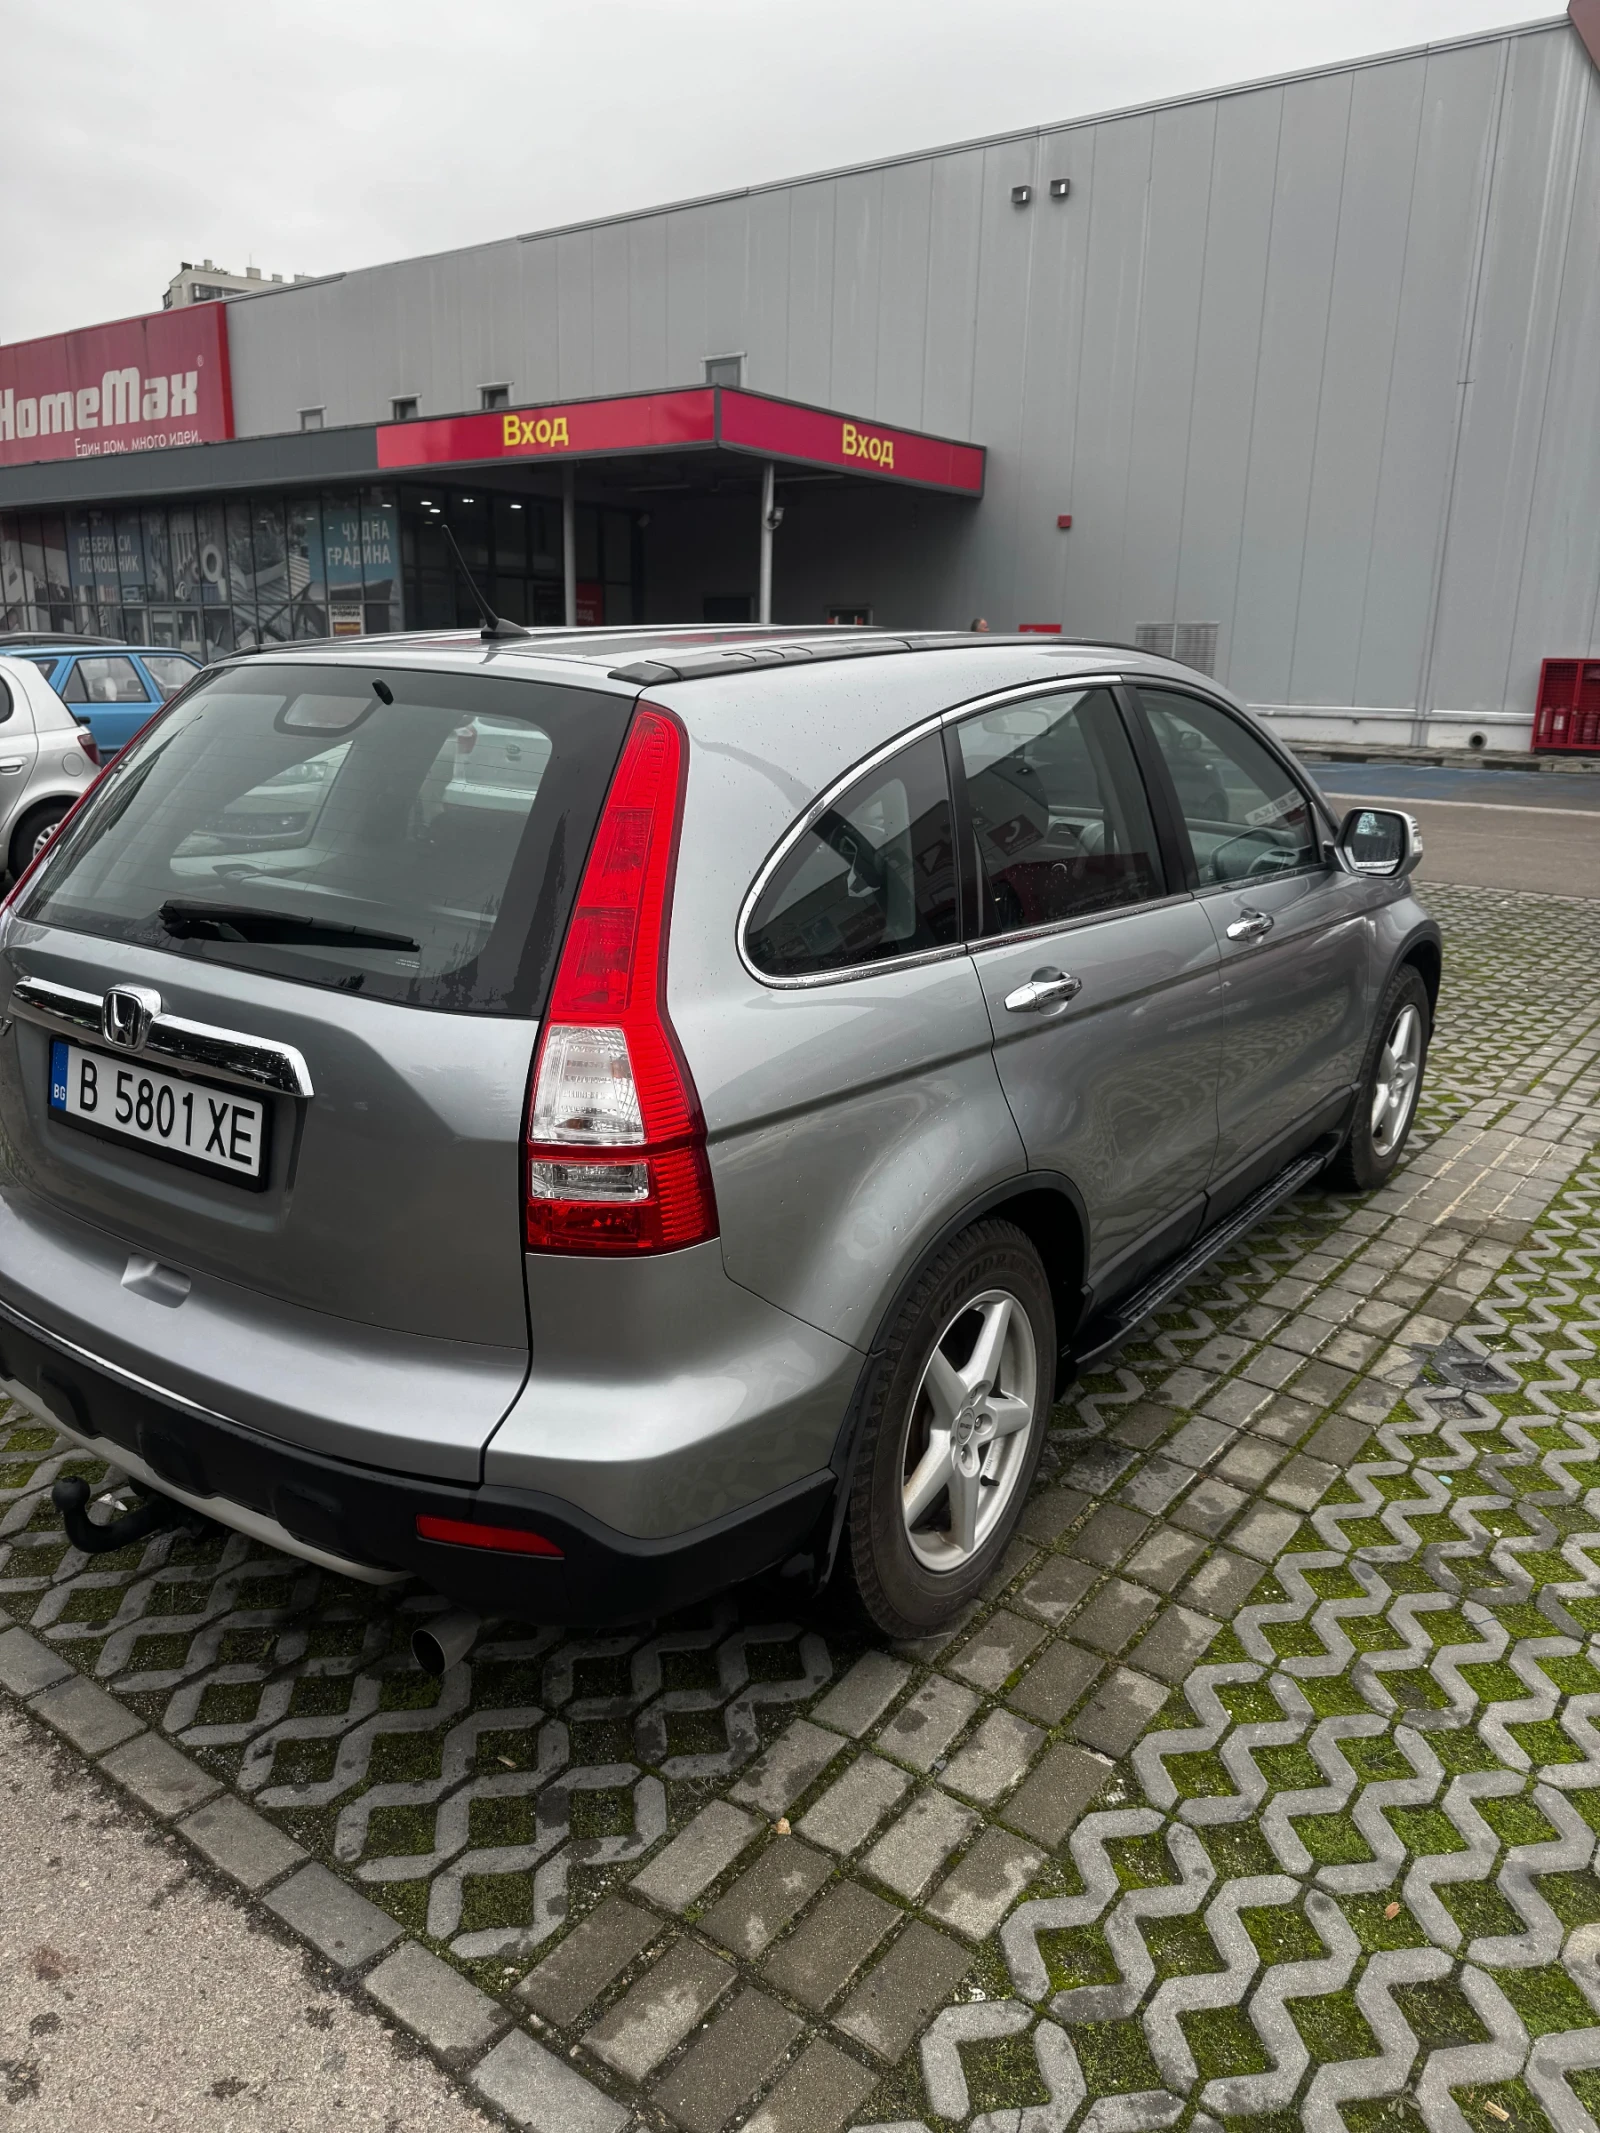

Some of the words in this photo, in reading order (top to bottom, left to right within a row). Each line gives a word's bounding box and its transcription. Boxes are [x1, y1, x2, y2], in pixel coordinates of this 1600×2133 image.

[0, 367, 198, 441] HomeMax
[503, 415, 569, 447] Вход
[74, 437, 100, 457] Един
[131, 434, 167, 451] много
[842, 423, 894, 469] Вход
[78, 536, 115, 553] ИЗБЕРИ
[118, 535, 131, 552] СИ
[342, 520, 390, 544] ЧУДНА
[327, 544, 391, 569] ГРАДИНА
[53, 1083, 66, 1101] BG
[80, 1058, 98, 1112] B
[115, 1070, 194, 1147] 5801
[205, 1097, 255, 1166] XE
